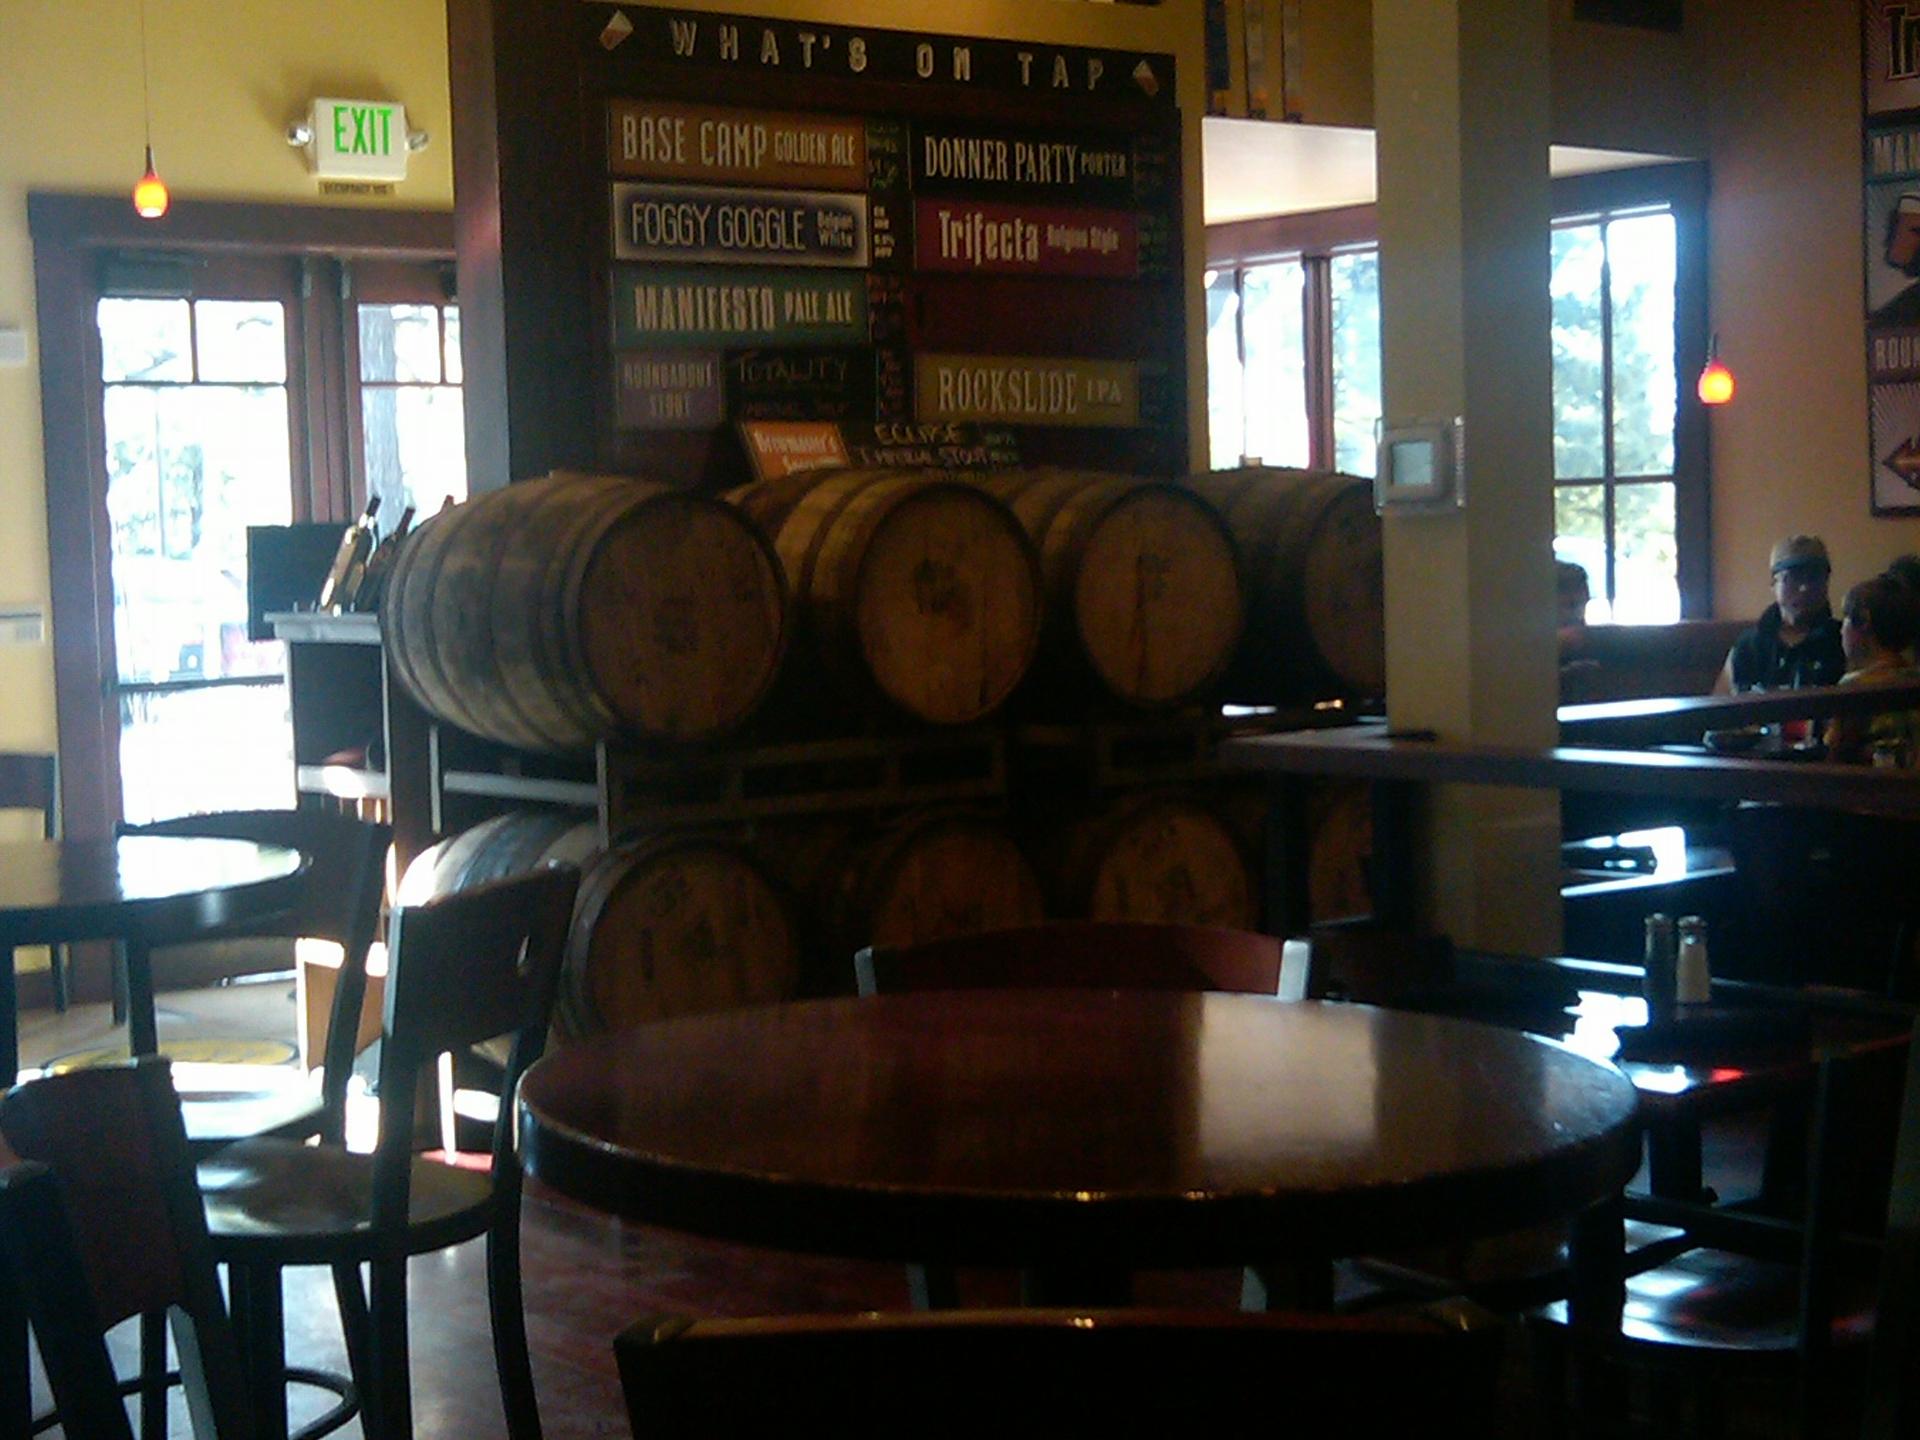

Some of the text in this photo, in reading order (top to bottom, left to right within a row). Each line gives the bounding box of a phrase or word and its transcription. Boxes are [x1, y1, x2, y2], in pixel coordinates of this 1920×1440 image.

[671, 19, 1104, 91] WHAT'S ON TAP
[334, 107, 392, 155] EXIT
[622, 114, 686, 164] BASE
[700, 120, 767, 170] CAMP
[774, 130, 826, 165] GOLDEN
[831, 133, 856, 167] ALE
[924, 136, 1009, 181] DONNER
[1014, 142, 1078, 185] PARTY
[631, 202, 806, 250] FOGGY GOGGLE
[938, 209, 1039, 266] Trifecta
[634, 285, 776, 332] MANIFESTO
[784, 290, 820, 323] PALE
[826, 289, 853, 323] ALE
[937, 366, 1078, 415] ROCKSLIDE
[1086, 380, 1122, 403] IPA
